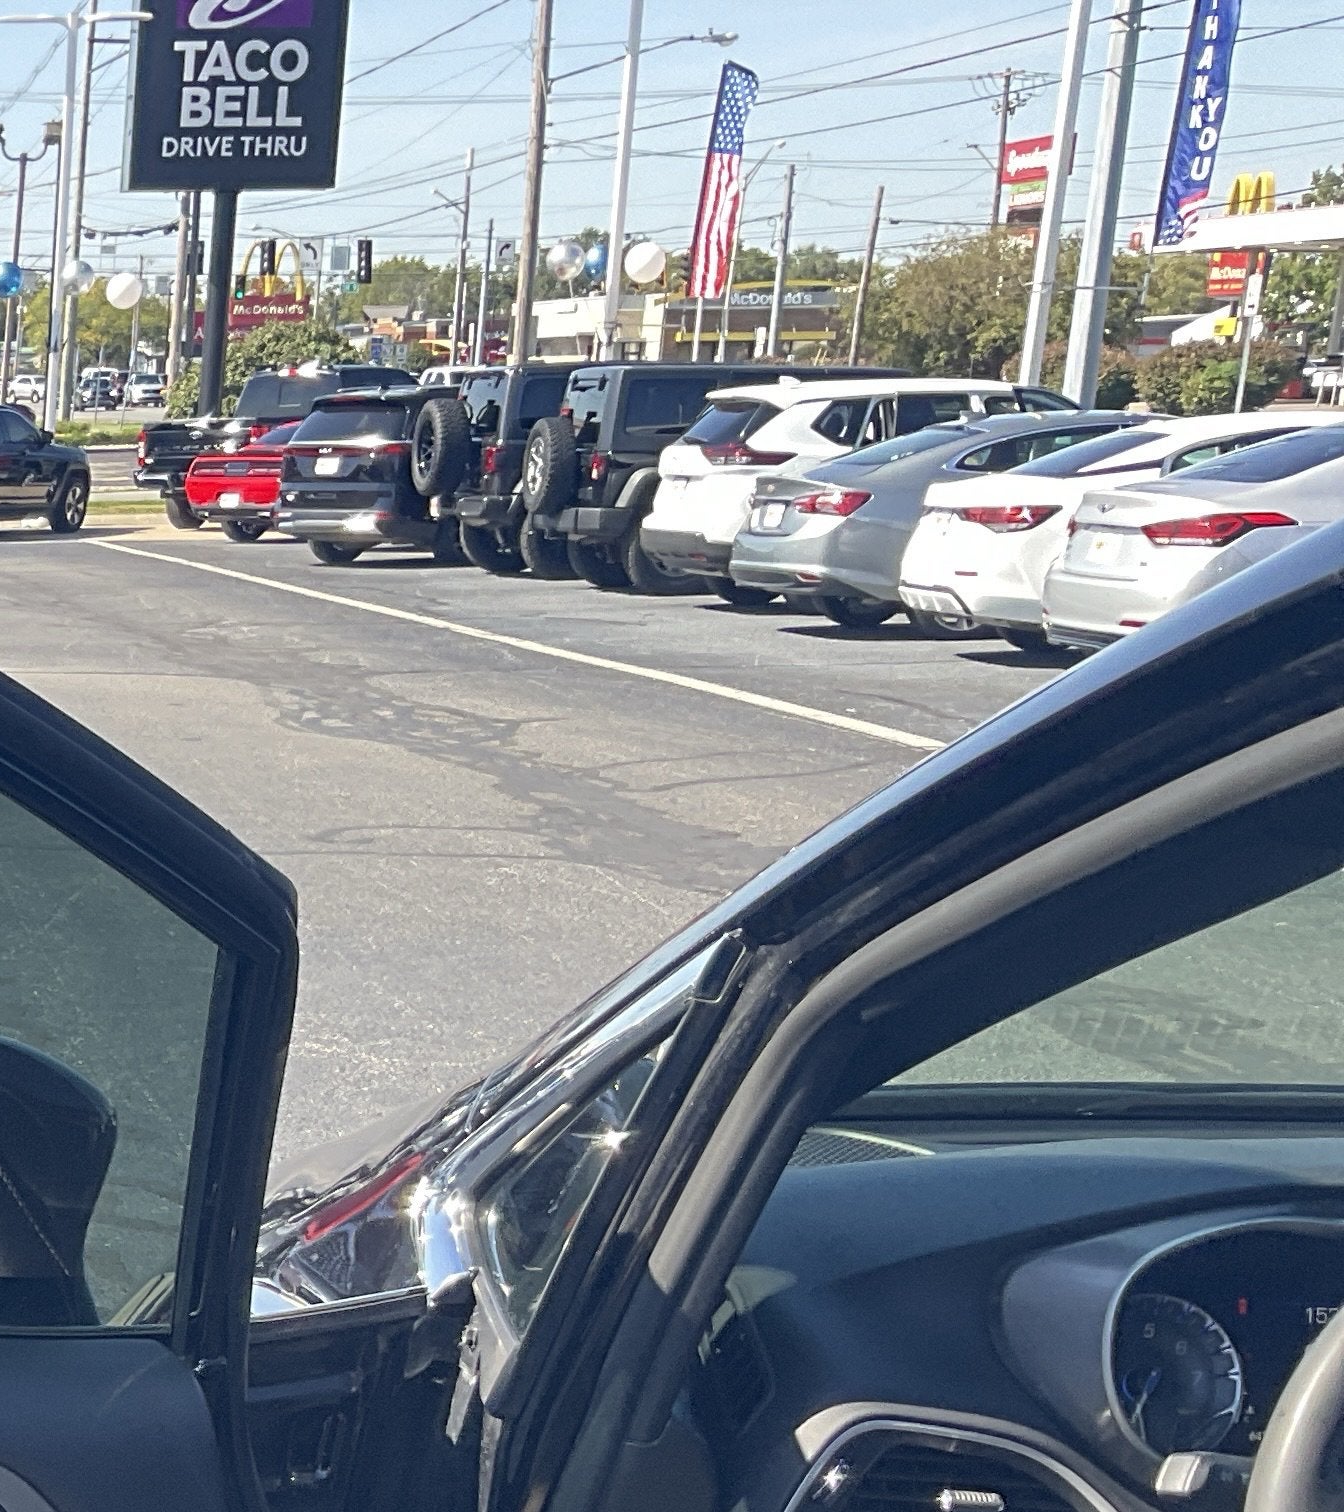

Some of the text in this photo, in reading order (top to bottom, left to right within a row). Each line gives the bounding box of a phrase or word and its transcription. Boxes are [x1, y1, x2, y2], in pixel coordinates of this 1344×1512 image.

[173, 38, 310, 83] TACO
[1189, 0, 1219, 128] HANK
[179, 85, 303, 128] BELL
[161, 135, 308, 158] DRIVE THRU
[1190, 96, 1223, 181] YOU
[232, 303, 304, 316] McDonald's
[1143, 1323, 1156, 1339] 5
